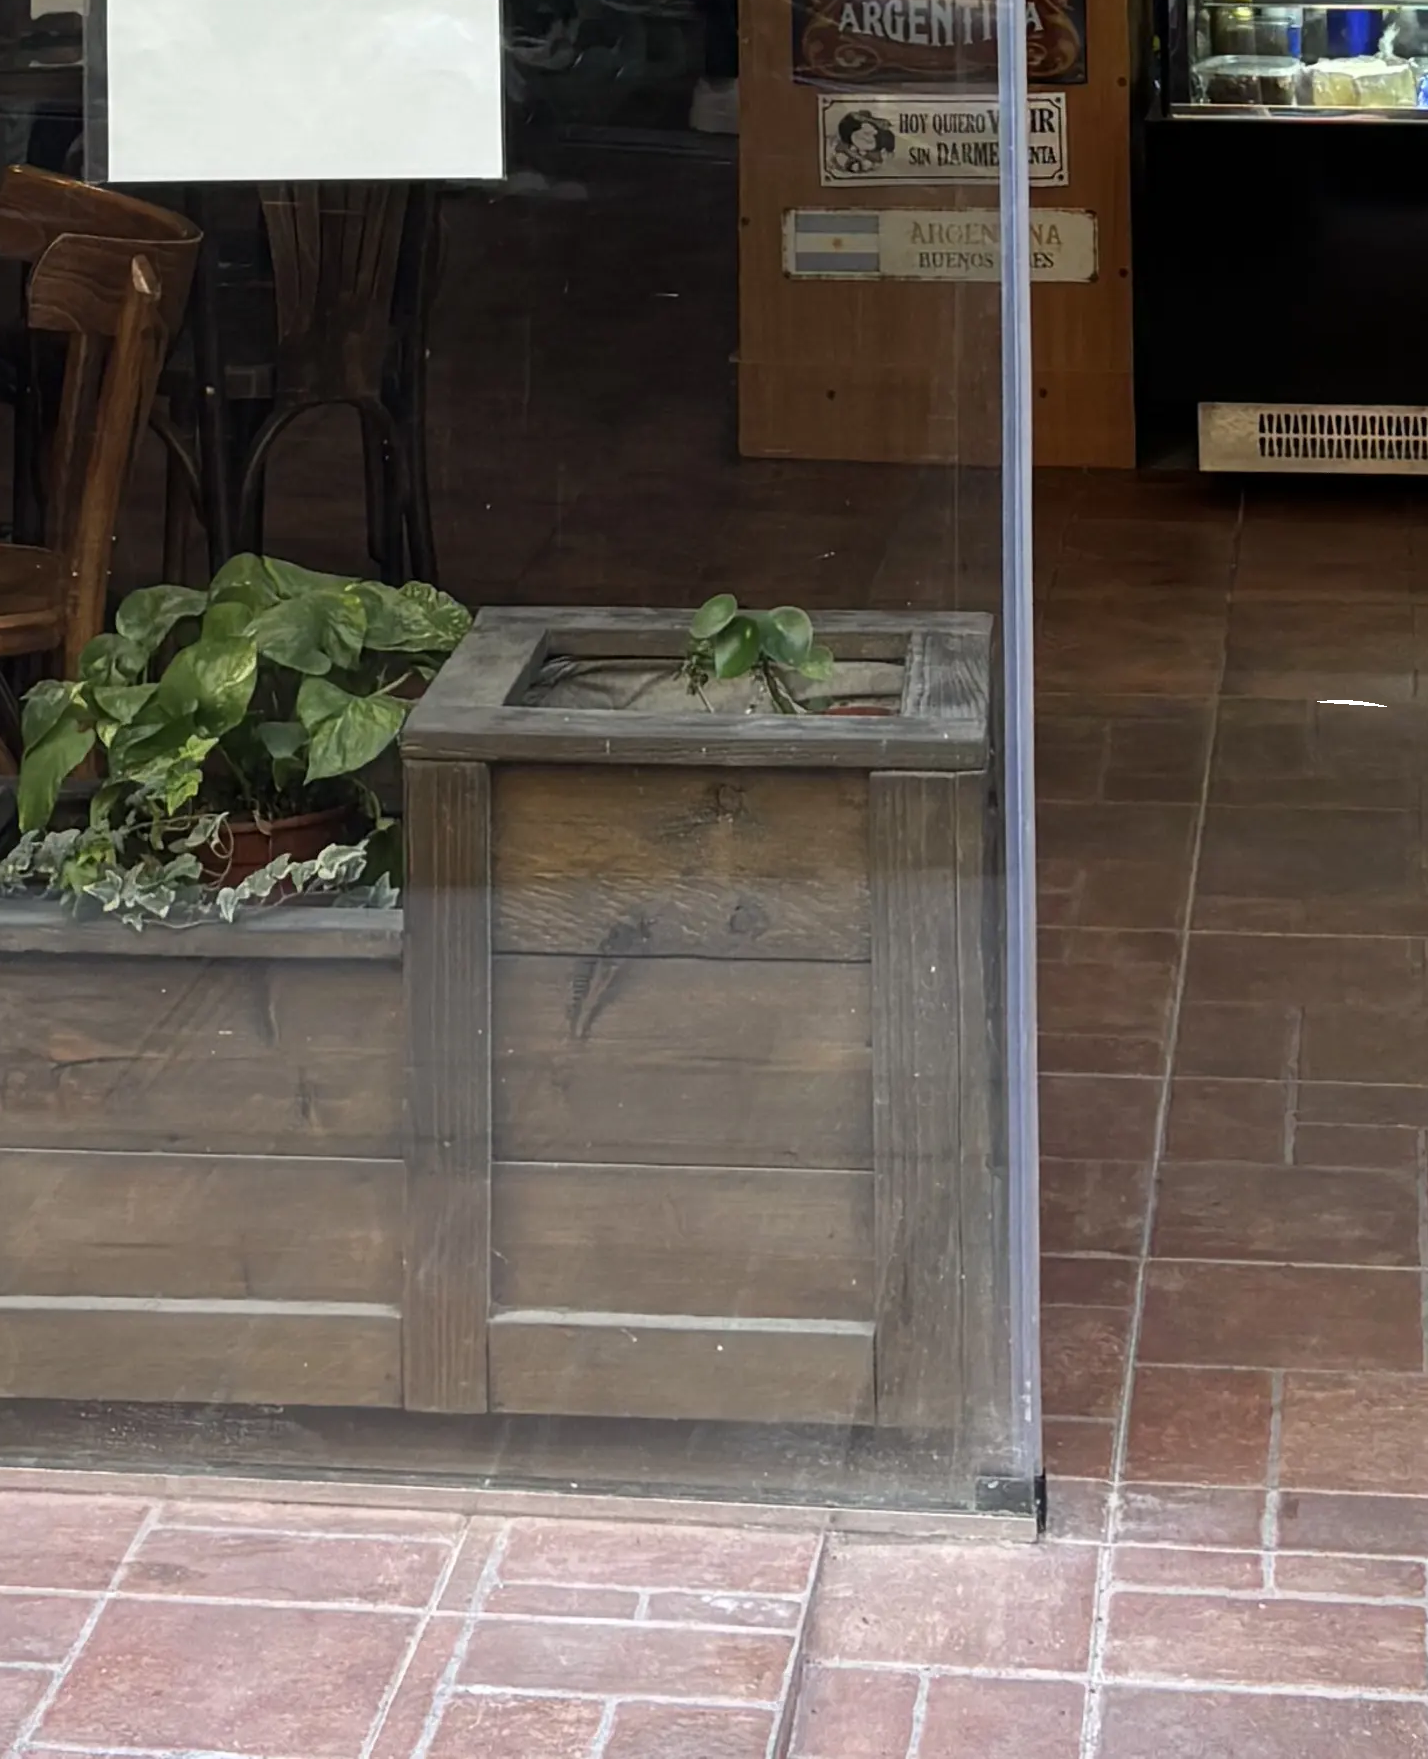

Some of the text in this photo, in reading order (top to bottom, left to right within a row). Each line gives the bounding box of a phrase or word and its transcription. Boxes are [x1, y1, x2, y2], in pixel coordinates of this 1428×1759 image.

[898, 108, 1056, 134] HOY QUIERO VIR
[908, 147, 931, 166] SIN
[936, 141, 999, 167] DARME
[910, 221, 1062, 245] ARGENNA
[919, 251, 994, 269] BUENOS
